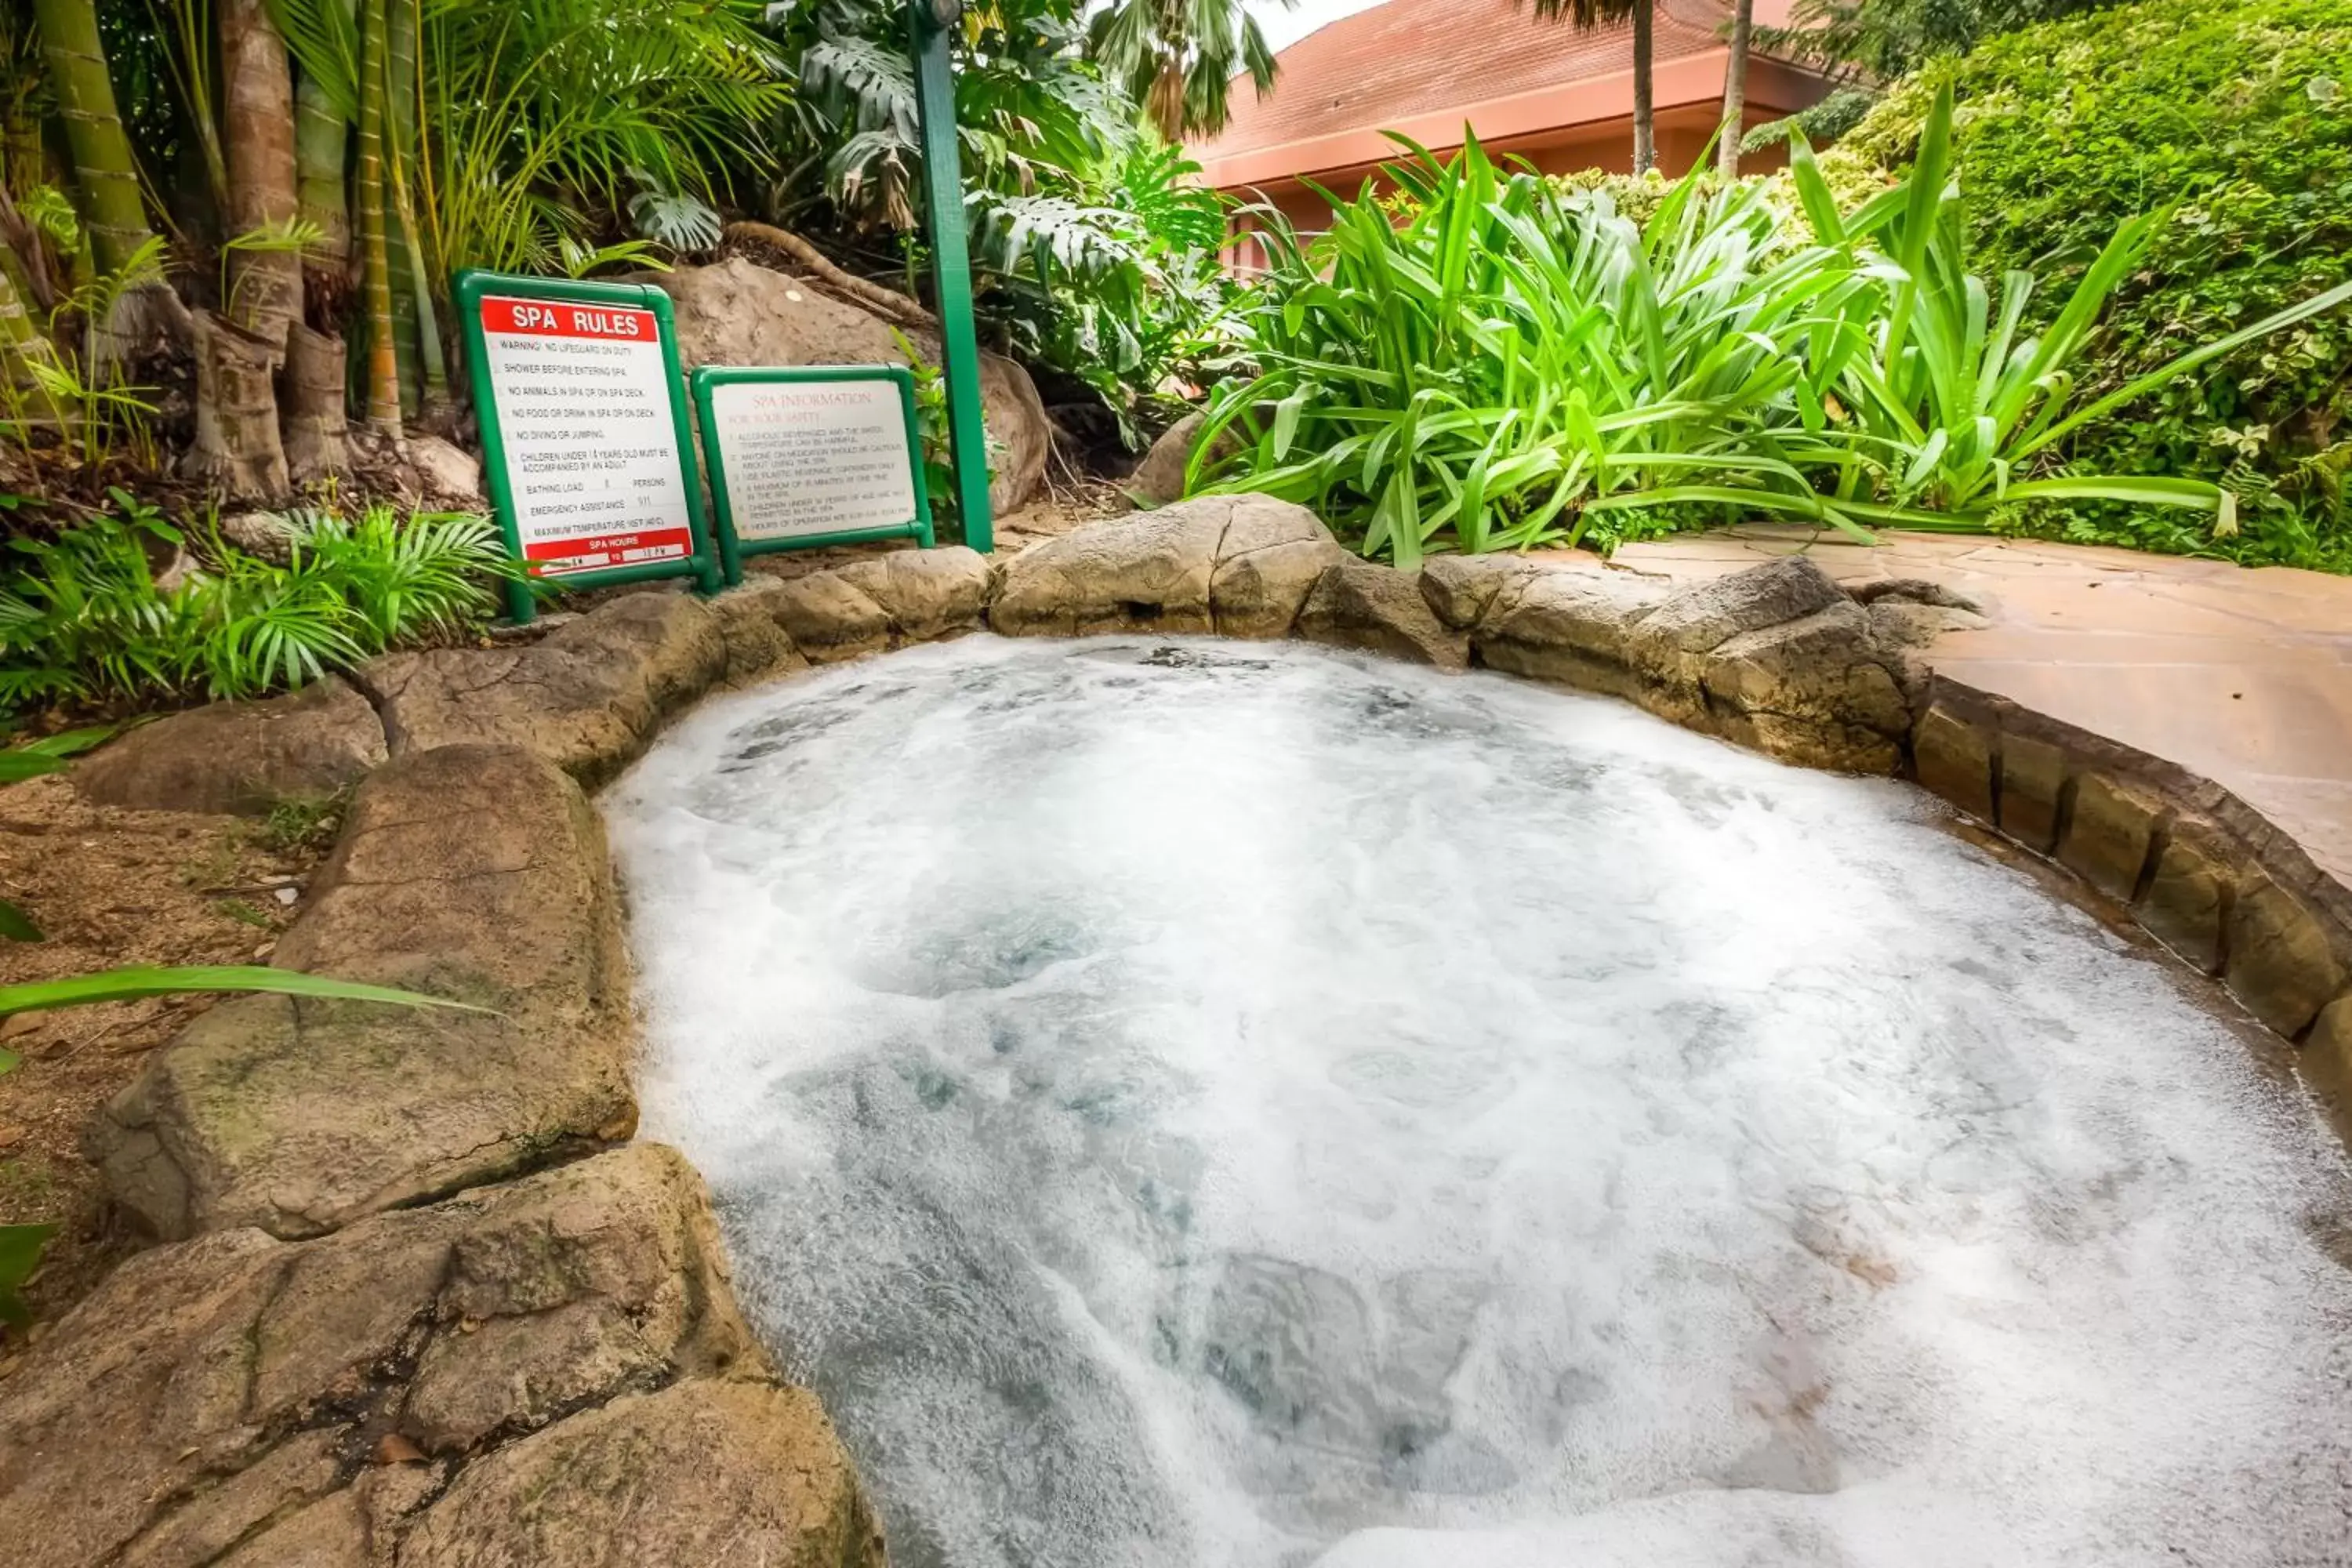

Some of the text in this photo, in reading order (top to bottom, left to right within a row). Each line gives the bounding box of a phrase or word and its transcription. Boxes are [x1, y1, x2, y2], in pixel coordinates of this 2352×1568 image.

[512, 305, 639, 336] SPA RULES
[504, 363, 540, 374] SHOWER
[542, 365, 574, 375] BEFORE
[575, 365, 610, 376] ENTERING
[508, 387, 520, 396] NO
[523, 387, 557, 397] ANIMALS
[568, 387, 583, 397] SPA
[609, 388, 623, 397] SPA
[752, 392, 872, 408] SPA INFORMATION
[512, 408, 524, 419] NO
[526, 408, 549, 418] FOOD
[550, 408, 562, 418] OR
[564, 408, 586, 418] DRINK
[597, 408, 612, 418] SPA
[517, 430, 528, 440] NO
[531, 430, 557, 440] DIVING
[558, 430, 570, 439] OR
[520, 452, 561, 463] CHILDREN
[562, 451, 587, 461] UNDER
[598, 449, 622, 459] YEARS
[624, 449, 637, 459] OLD
[639, 448, 657, 458] MUST
[659, 448, 670, 457] BE
[523, 461, 579, 473] ACCOMPANIED
[581, 462, 591, 471] BY
[592, 462, 603, 470] AN
[526, 483, 561, 494] BATHING
[562, 481, 584, 492] LOAD
[633, 477, 666, 487] PERSONS
[530, 503, 578, 517] EMERGENCY
[580, 499, 625, 513] ASSISTANCE
[534, 524, 572, 537] MAXIMUM
[573, 520, 625, 535] TEMPERATURE
[589, 536, 639, 550] SPA HOURS
